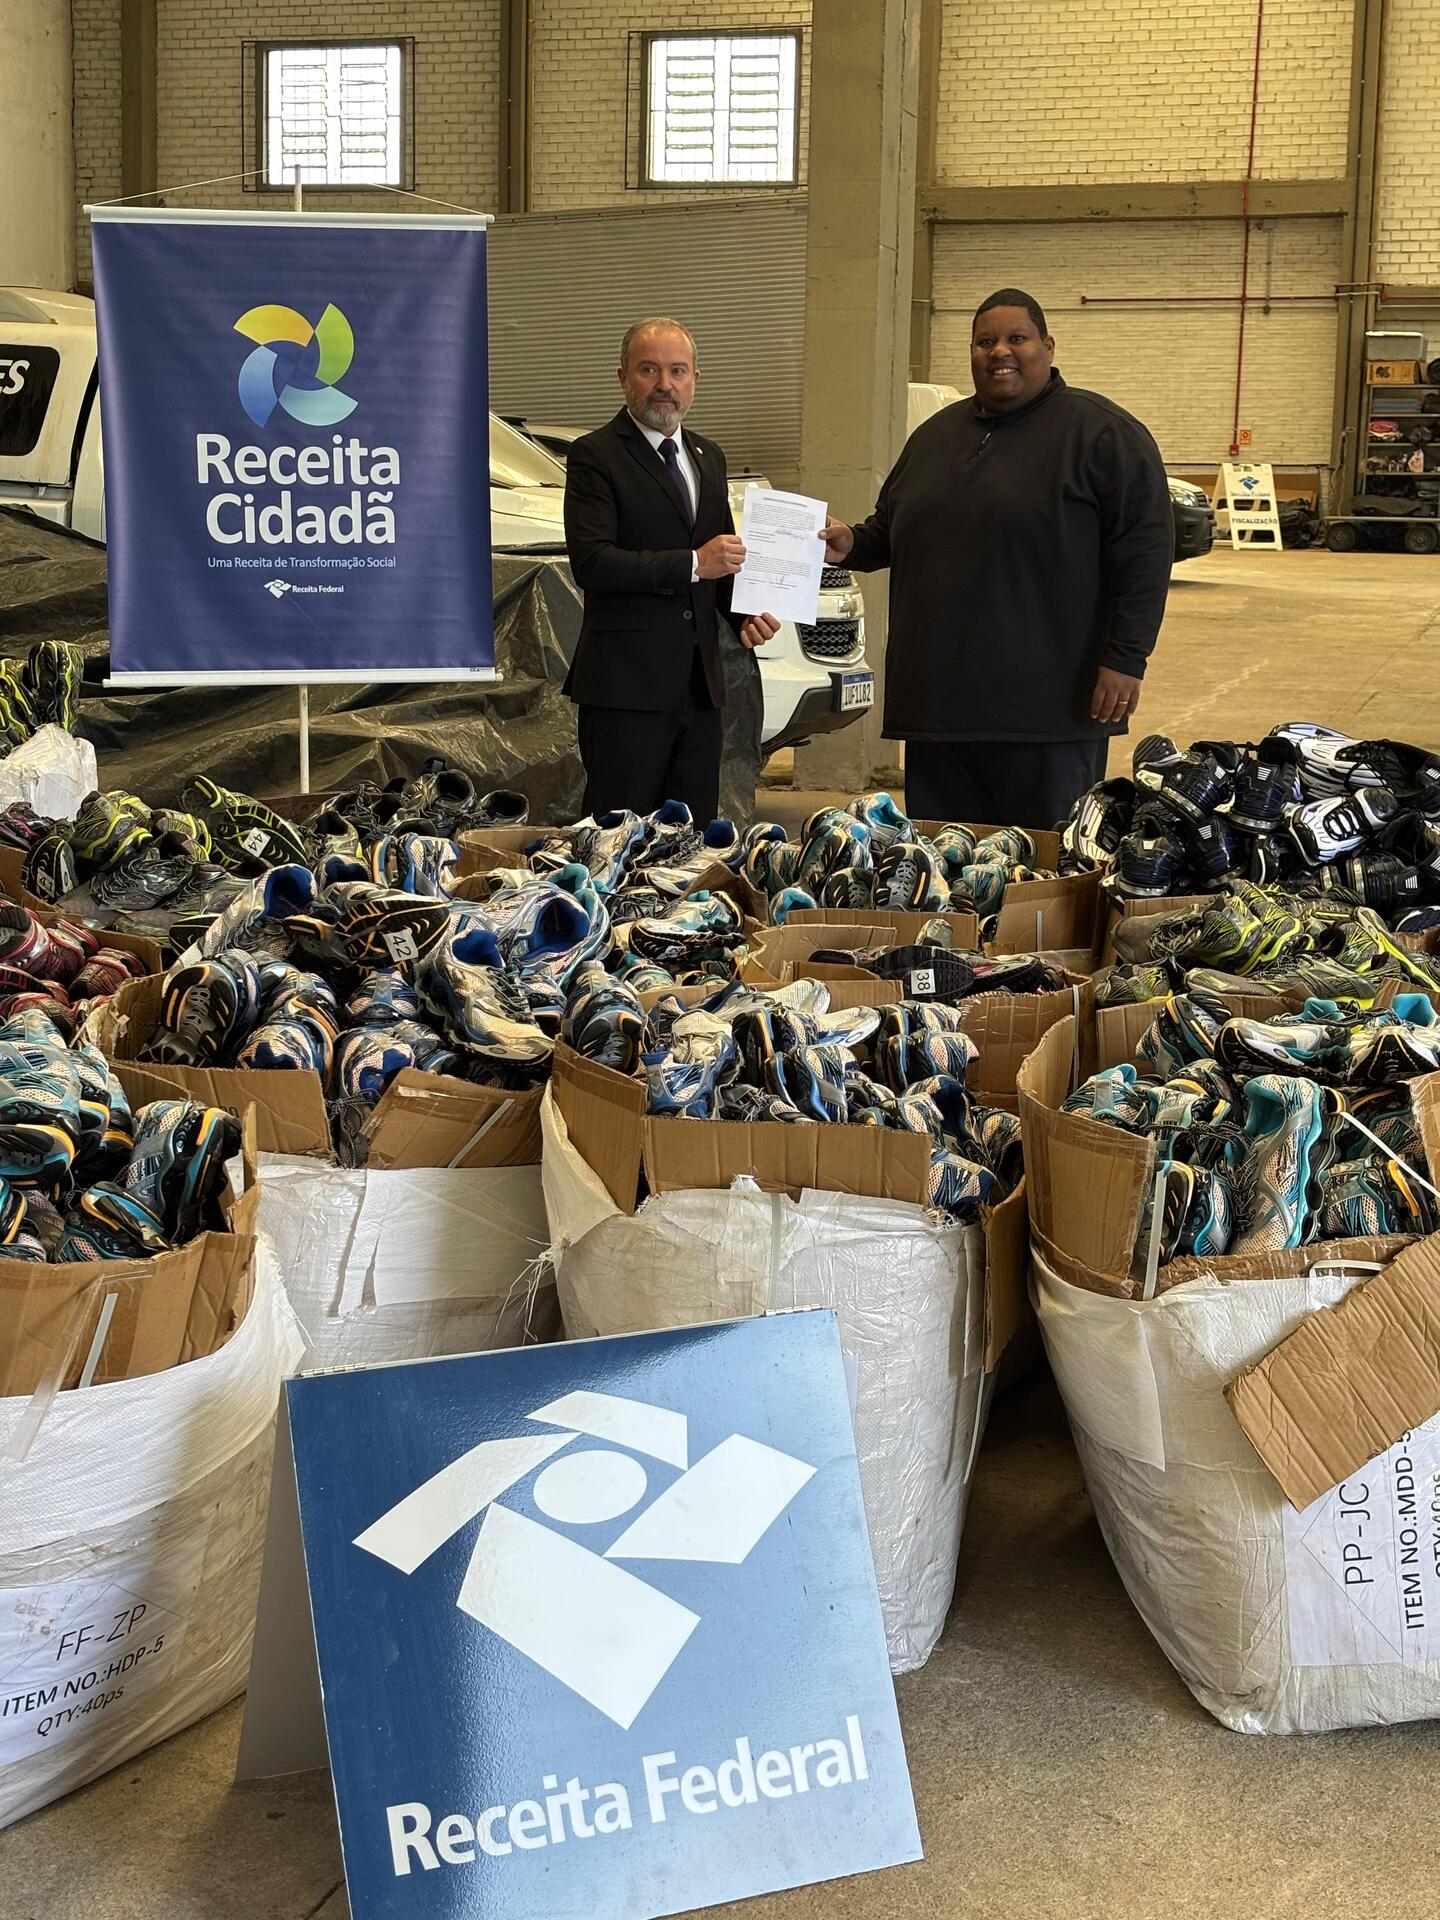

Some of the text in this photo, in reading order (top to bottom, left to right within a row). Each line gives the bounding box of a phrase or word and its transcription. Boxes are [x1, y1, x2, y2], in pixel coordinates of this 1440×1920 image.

[196, 433, 400, 486] Receita
[206, 490, 396, 545] Cidadã
[207, 556, 396, 570] Uma Receita de Transformação Social
[292, 585, 344, 593] Receita Federal
[248, 833, 263, 852] 44
[393, 935, 412, 958] 42
[916, 972, 931, 991] 38
[1402, 1572, 1425, 1631] ITEM
[56, 1603, 147, 1661] FF-ZP
[2, 1634, 165, 1717] ITEM NO.:HDP-5
[37, 1686, 124, 1737] QTY:40ps
[386, 1714, 869, 1876] Receita Federal
